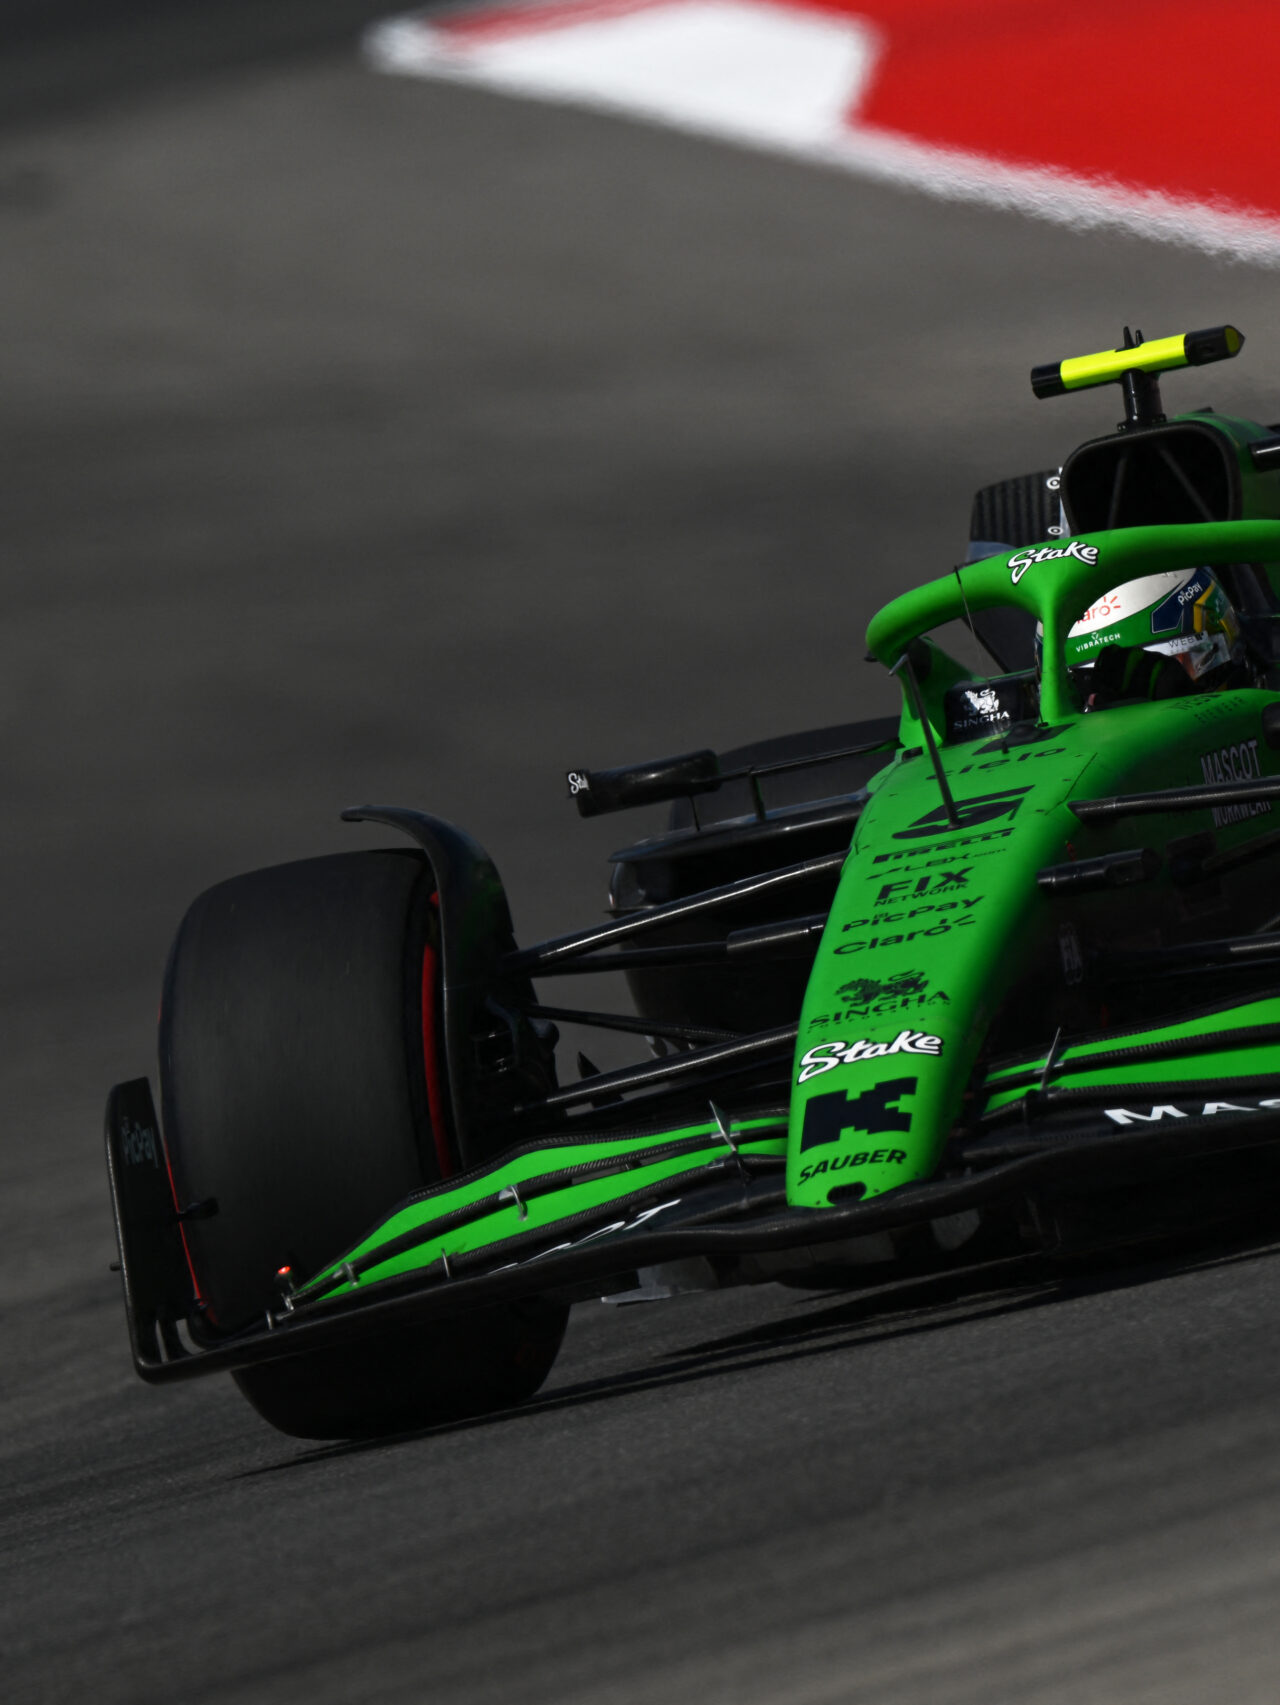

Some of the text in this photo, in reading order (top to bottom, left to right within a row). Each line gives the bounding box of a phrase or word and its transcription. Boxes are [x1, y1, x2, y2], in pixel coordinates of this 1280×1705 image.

[1007, 541, 1099, 585] Stake
[1177, 581, 1204, 606] PicPay
[1075, 632, 1121, 653] VIBRATECH
[952, 710, 1010, 728] SINGHA
[1201, 739, 1261, 785] MASCOT
[873, 883, 968, 907] NETWORK
[876, 866, 975, 901] FIX
[841, 895, 985, 933] PicPay
[833, 922, 954, 955] Claro
[809, 990, 951, 1026] SINGHA
[796, 1029, 944, 1085] Stake
[797, 1149, 907, 1186] SAUBER
